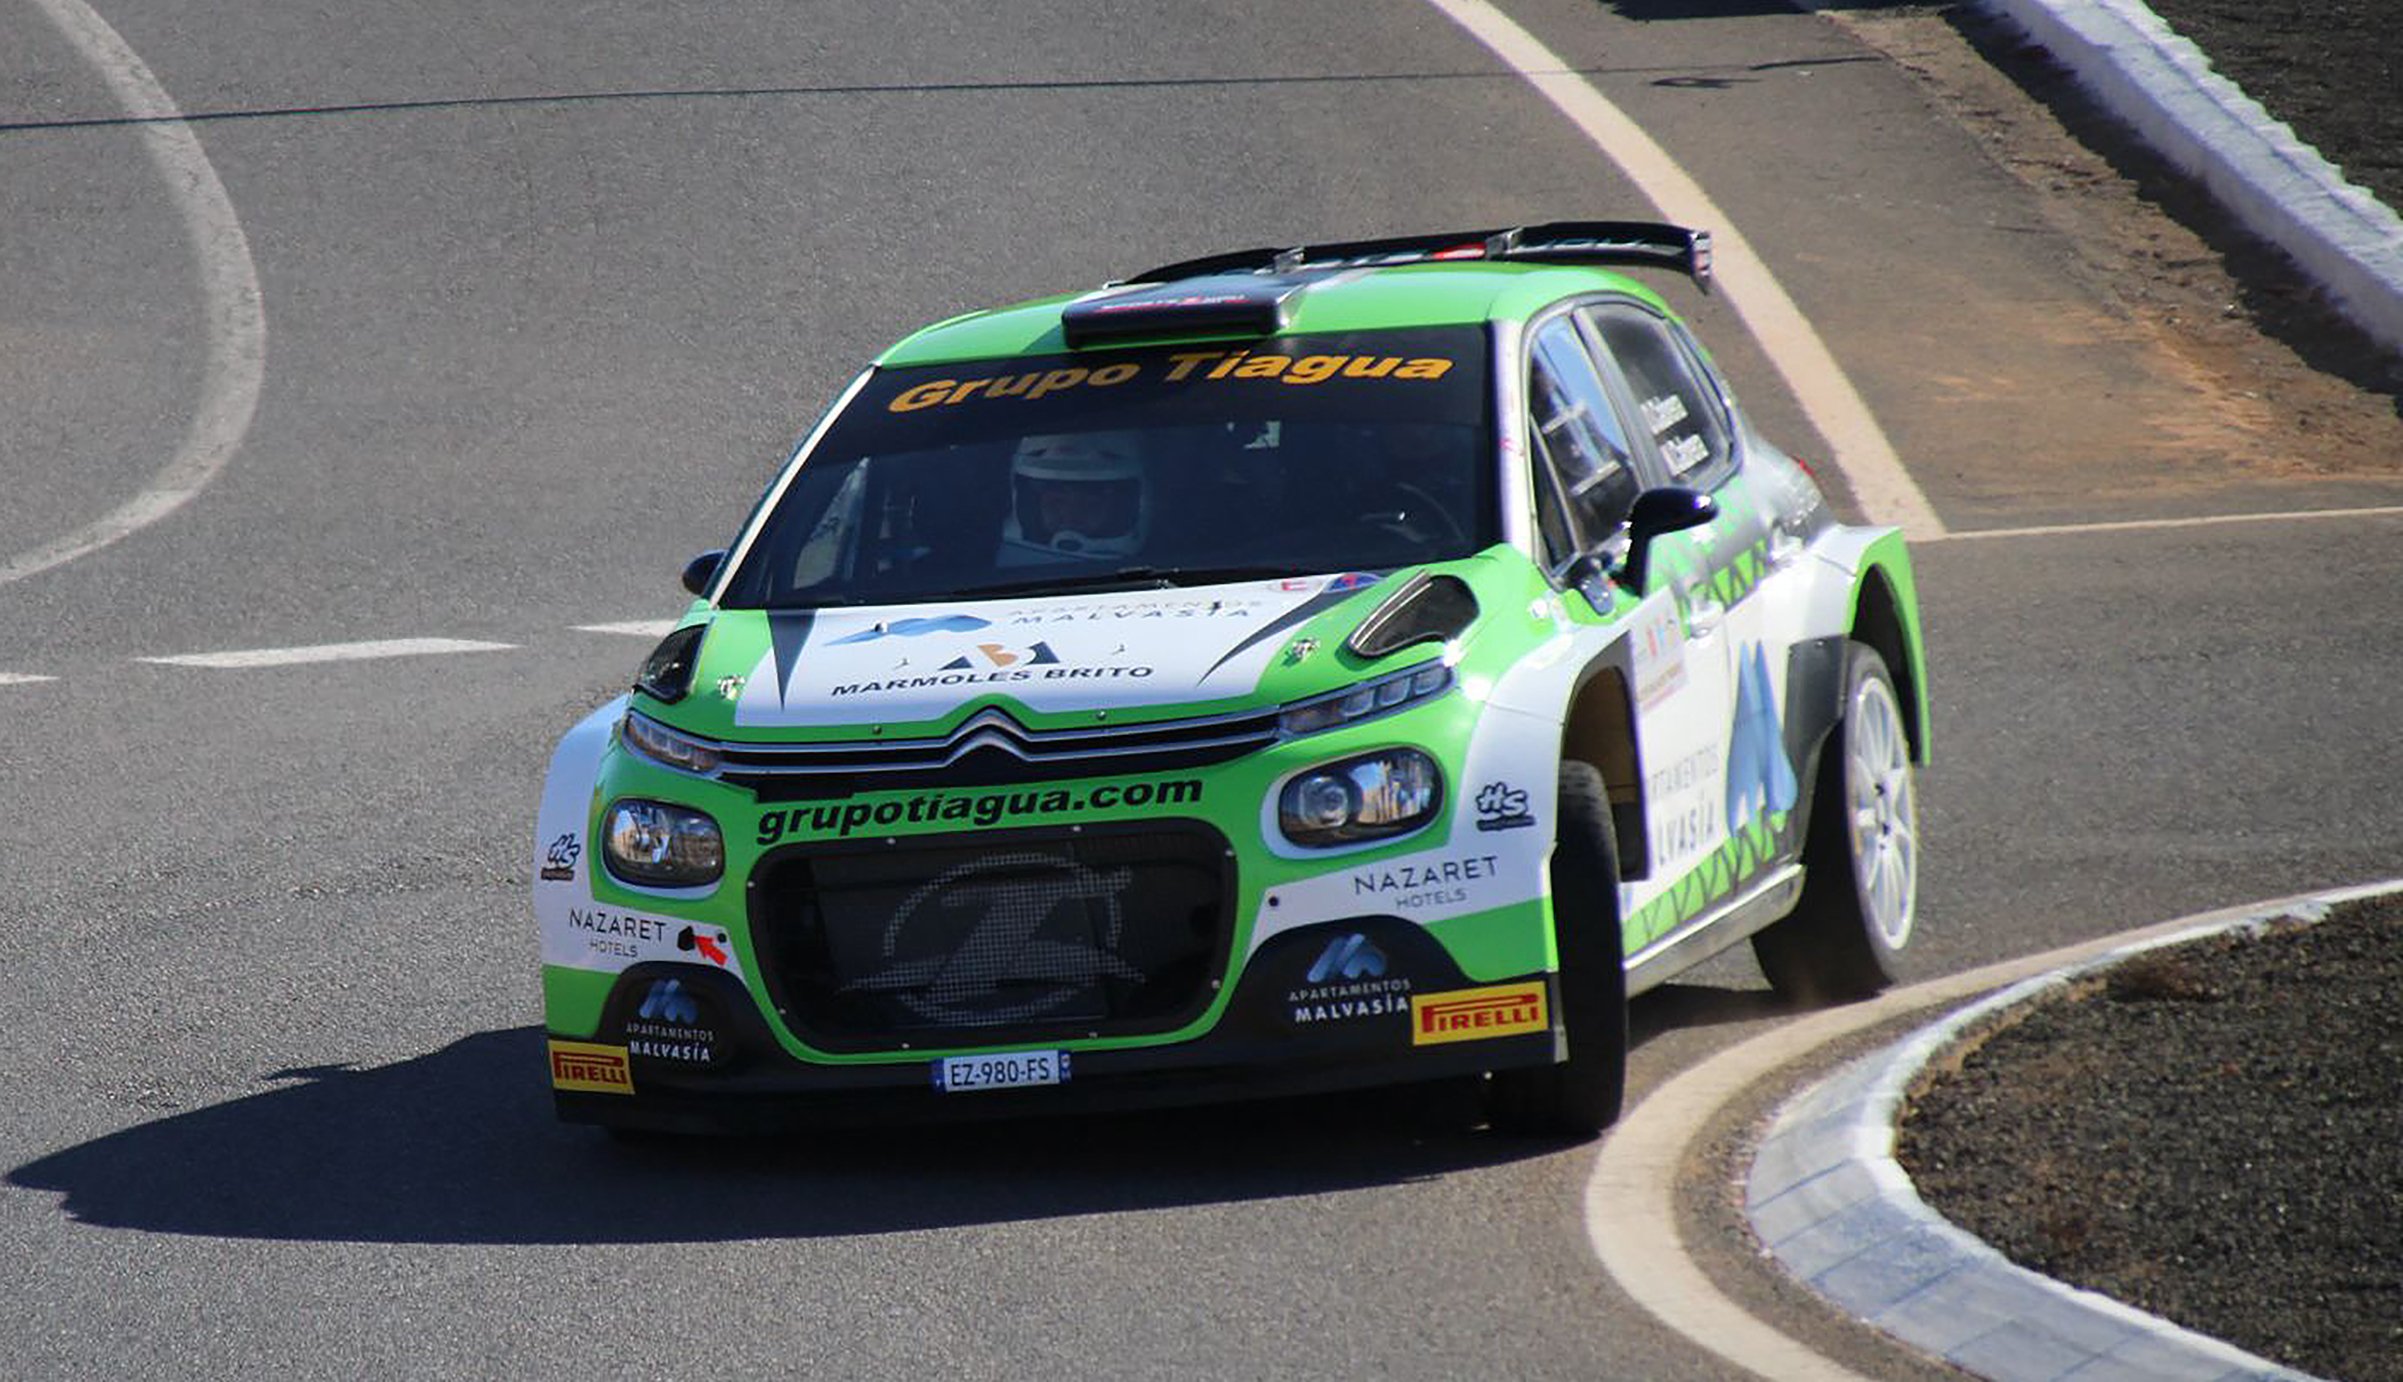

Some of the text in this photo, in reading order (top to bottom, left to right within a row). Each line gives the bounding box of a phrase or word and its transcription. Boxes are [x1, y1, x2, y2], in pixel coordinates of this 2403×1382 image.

[889, 349, 1454, 413] Grupo Tiagua
[832, 666, 1155, 697] MARMOLES BRITO
[756, 778, 1203, 845] grupotiagua.com
[1354, 855, 1499, 896] NAZARET
[1396, 887, 1467, 910] HOTELS
[569, 908, 667, 942] NAZARET
[589, 939, 639, 958] HOTELS
[1288, 978, 1412, 1002] APARTAMENTOS
[1294, 992, 1410, 1024] MALVASÍA
[1419, 992, 1540, 1034] PIRELLI
[626, 1021, 715, 1042] APARTAMENTOS
[630, 1040, 712, 1063] MALVASÍA
[552, 1051, 628, 1085] PIRELLI
[950, 1057, 1050, 1087] EZ-980-FS
